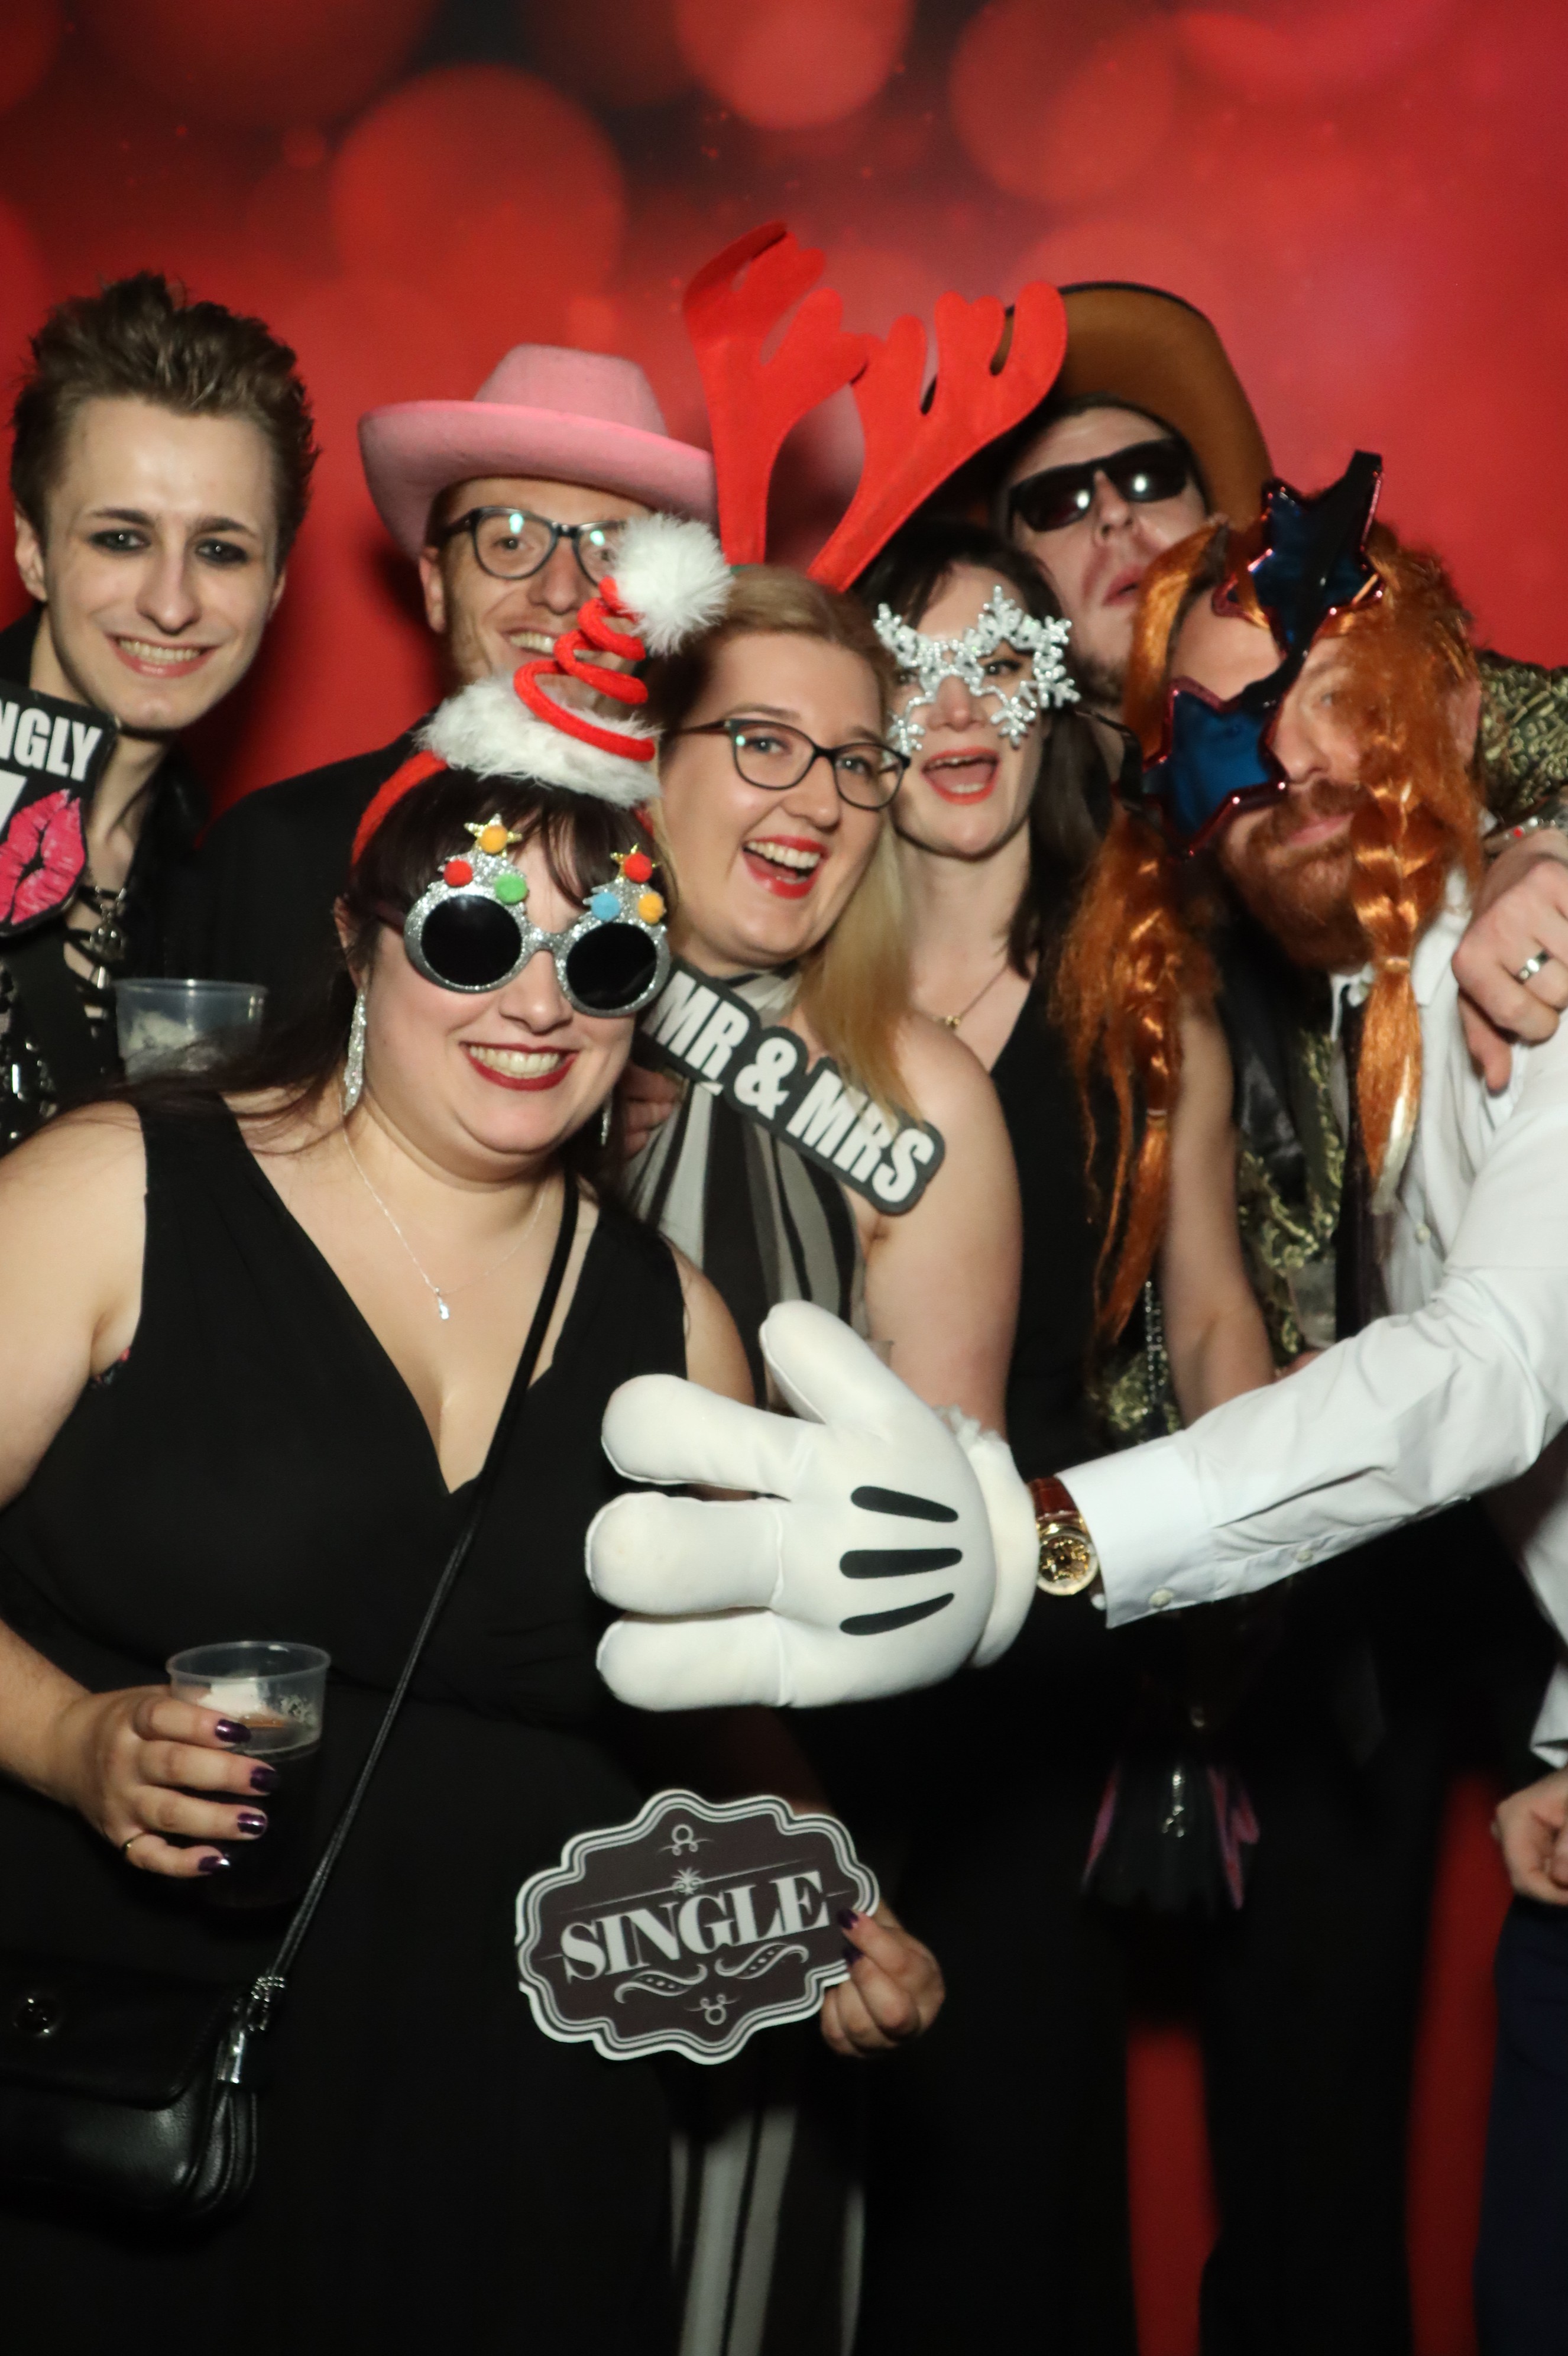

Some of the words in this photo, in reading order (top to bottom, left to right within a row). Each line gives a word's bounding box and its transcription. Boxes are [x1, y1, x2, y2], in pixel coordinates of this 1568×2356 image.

[642, 970, 750, 1080] MR
[734, 1037, 798, 1120] &
[785, 1069, 935, 1203] MRS
[560, 1870, 830, 1985] SINGLE
